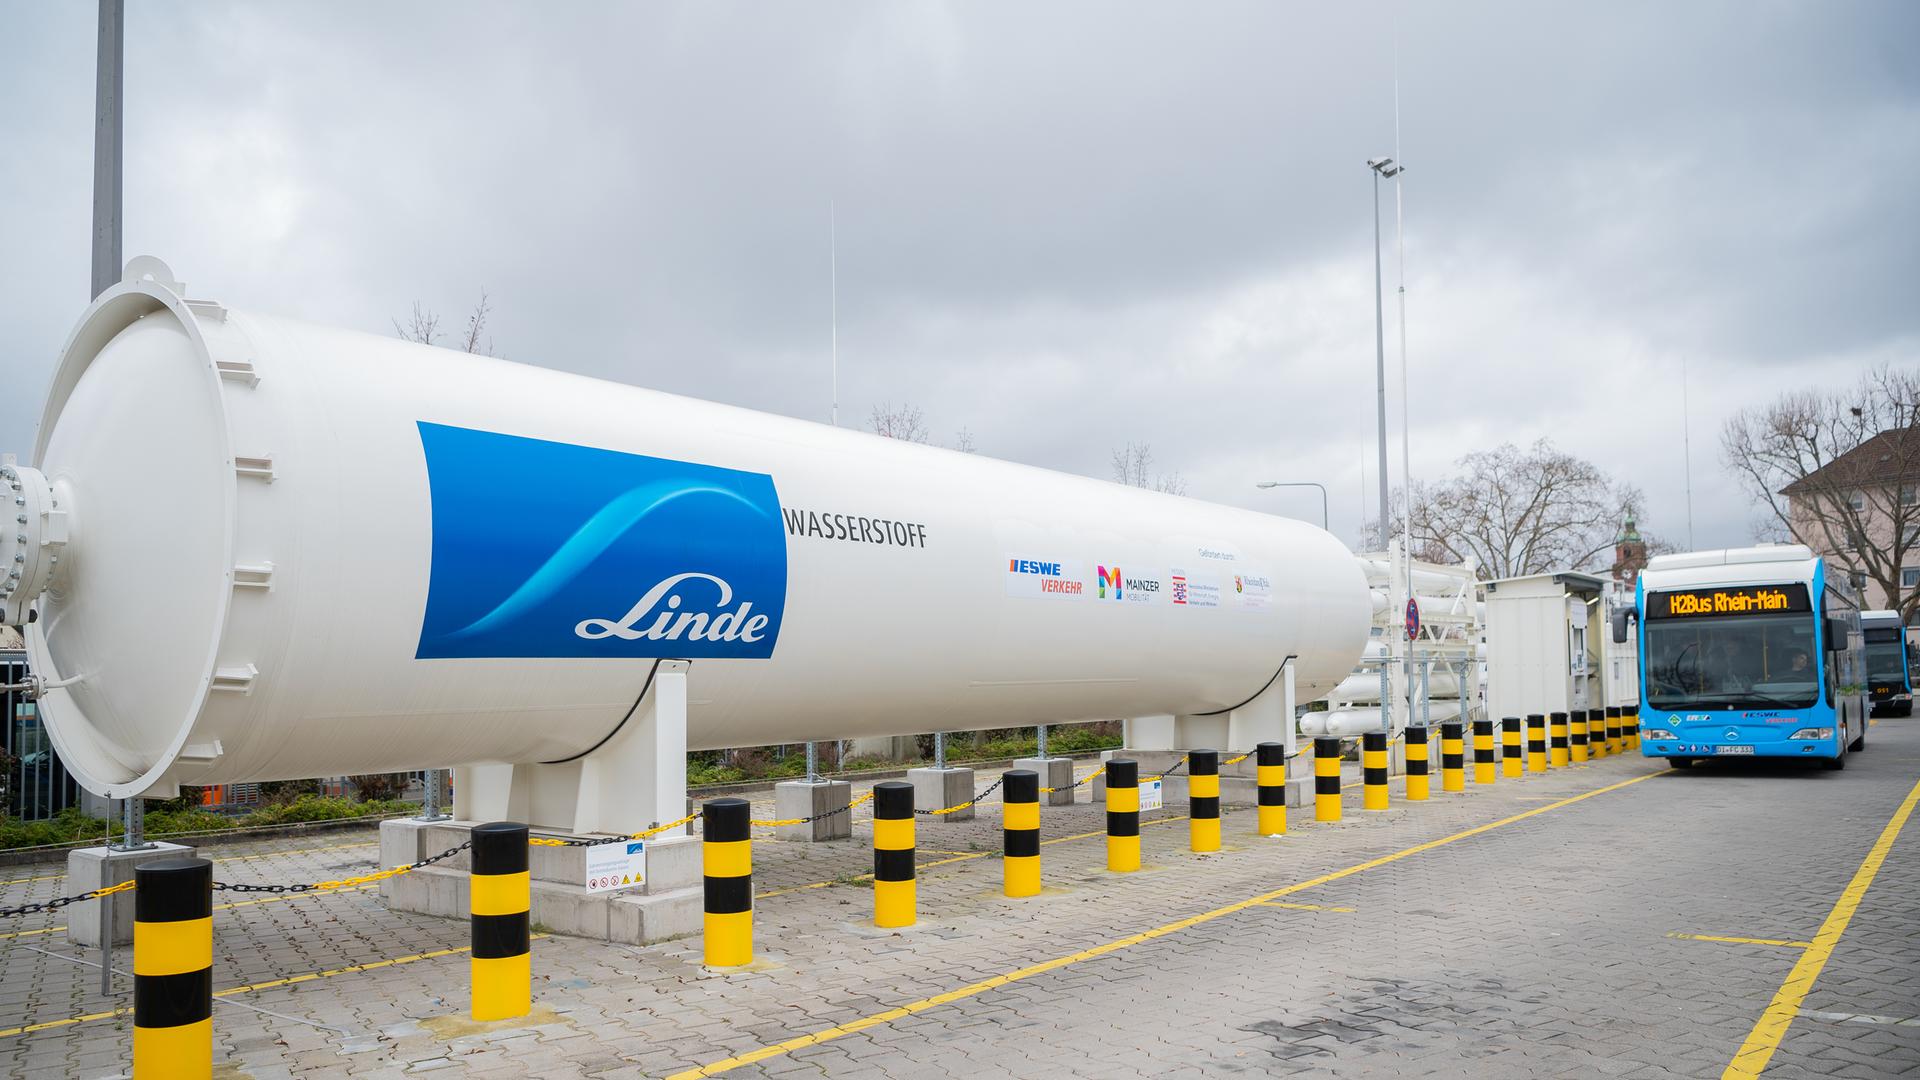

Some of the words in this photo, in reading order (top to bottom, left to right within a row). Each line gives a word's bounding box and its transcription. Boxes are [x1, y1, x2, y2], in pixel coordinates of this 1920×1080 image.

[782, 507, 927, 549] WASSERSTOFF
[1019, 560, 1061, 576] ESWE
[1041, 578, 1083, 595] VERKEHR
[1126, 578, 1160, 593] MAINZER
[574, 572, 769, 643] Linde
[1669, 594, 1712, 614] H2Bus
[1714, 589, 1788, 611] Rhein-Main
